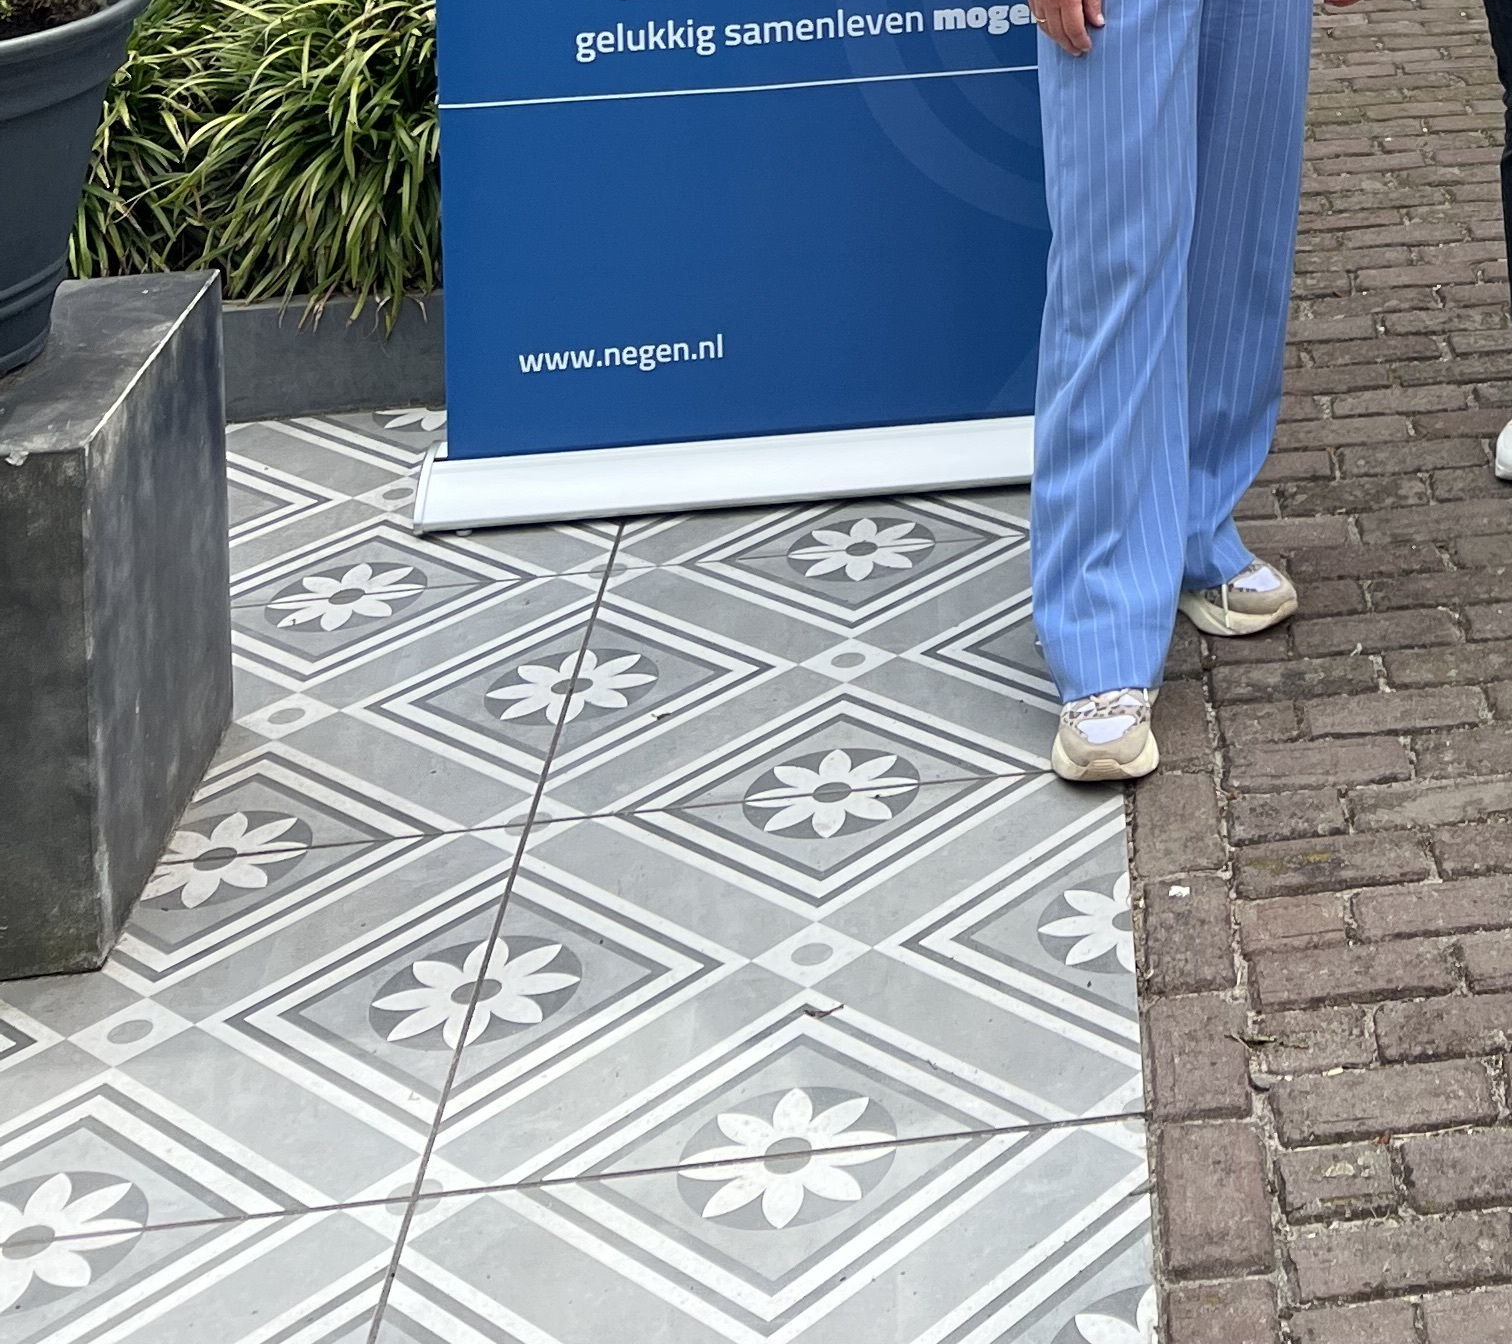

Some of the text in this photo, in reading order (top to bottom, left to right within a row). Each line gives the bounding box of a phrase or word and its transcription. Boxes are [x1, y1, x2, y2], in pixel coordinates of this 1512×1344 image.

[575, 3, 1037, 63] gelukkig samenleven moge
[518, 333, 723, 373] www.negen.nl
